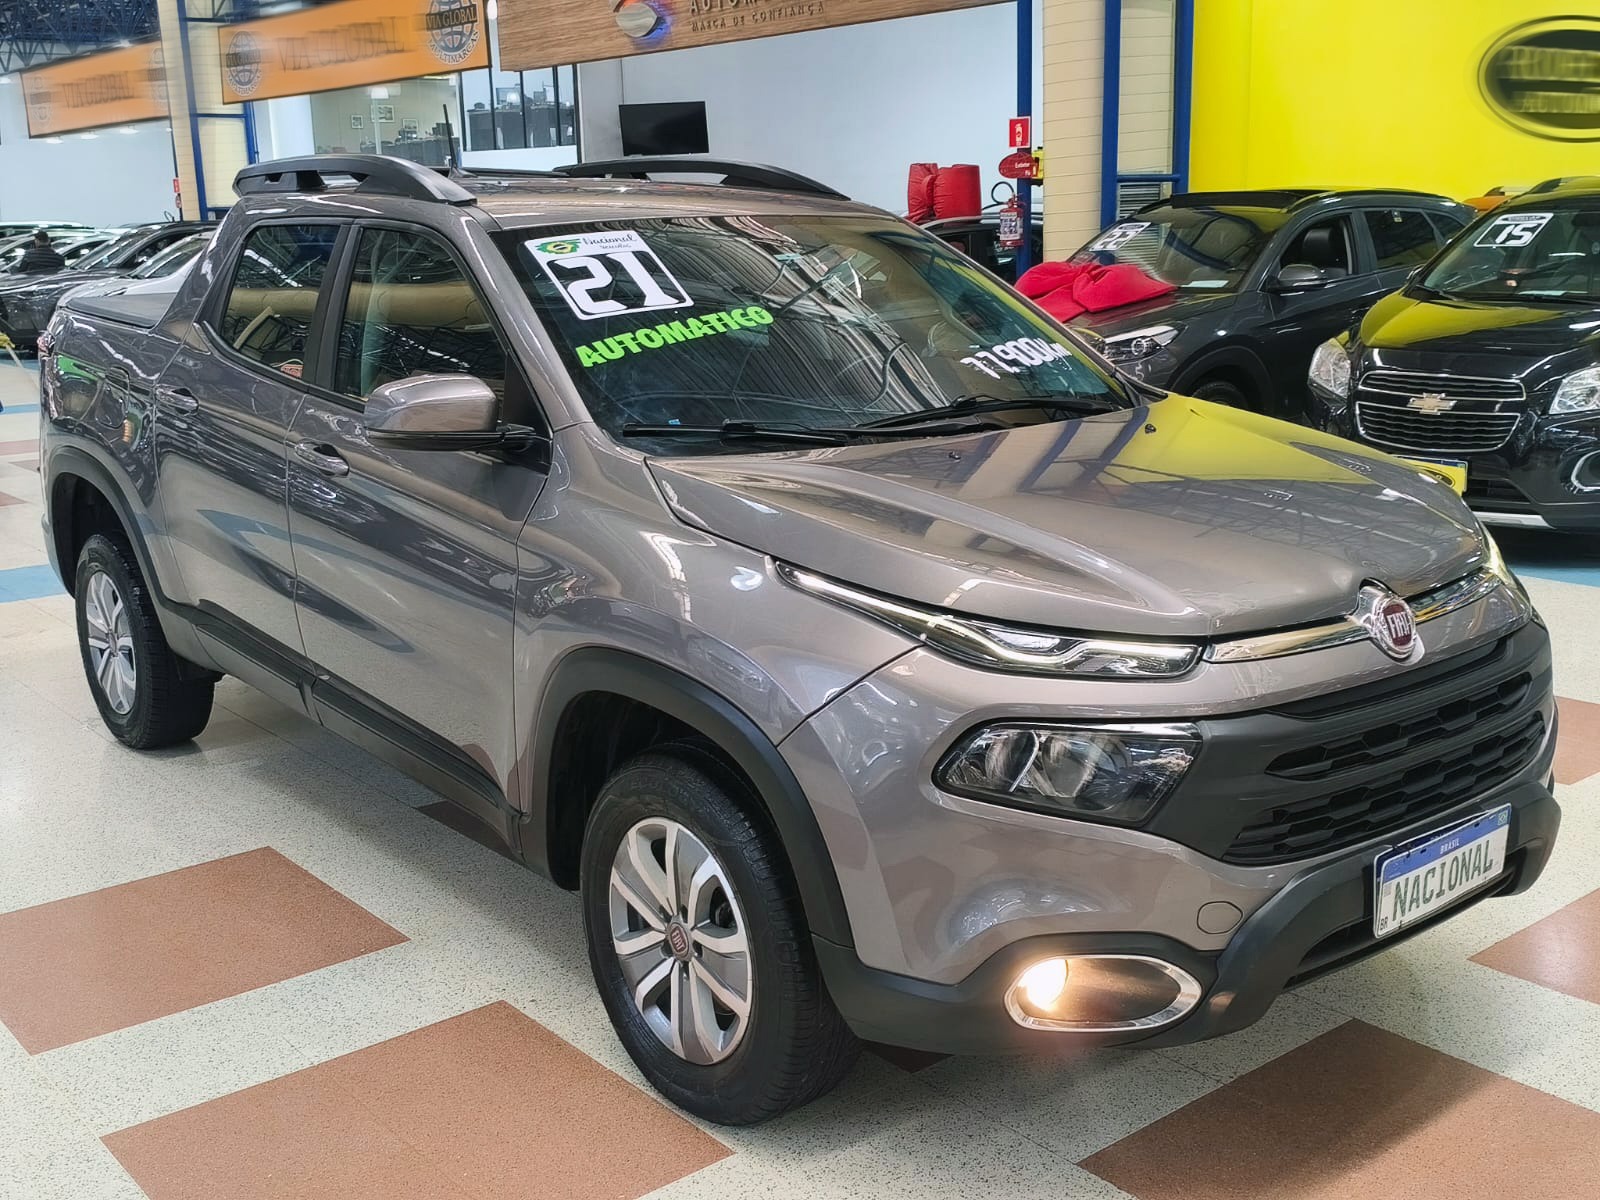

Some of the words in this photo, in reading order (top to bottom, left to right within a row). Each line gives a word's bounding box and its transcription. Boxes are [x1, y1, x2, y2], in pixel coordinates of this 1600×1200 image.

[426, 14, 442, 29] VIA
[444, 7, 477, 27] GLOBAL
[733, 15, 745, 27] DE
[752, 2, 824, 24] CONFIANÇA
[1495, 224, 1538, 245] 15
[554, 251, 679, 314] 21
[575, 306, 774, 368] AUTOMATICO
[1386, 611, 1411, 639] FIAT
[1440, 838, 1460, 855] BRASIL
[1392, 840, 1493, 921] NACIONAL
